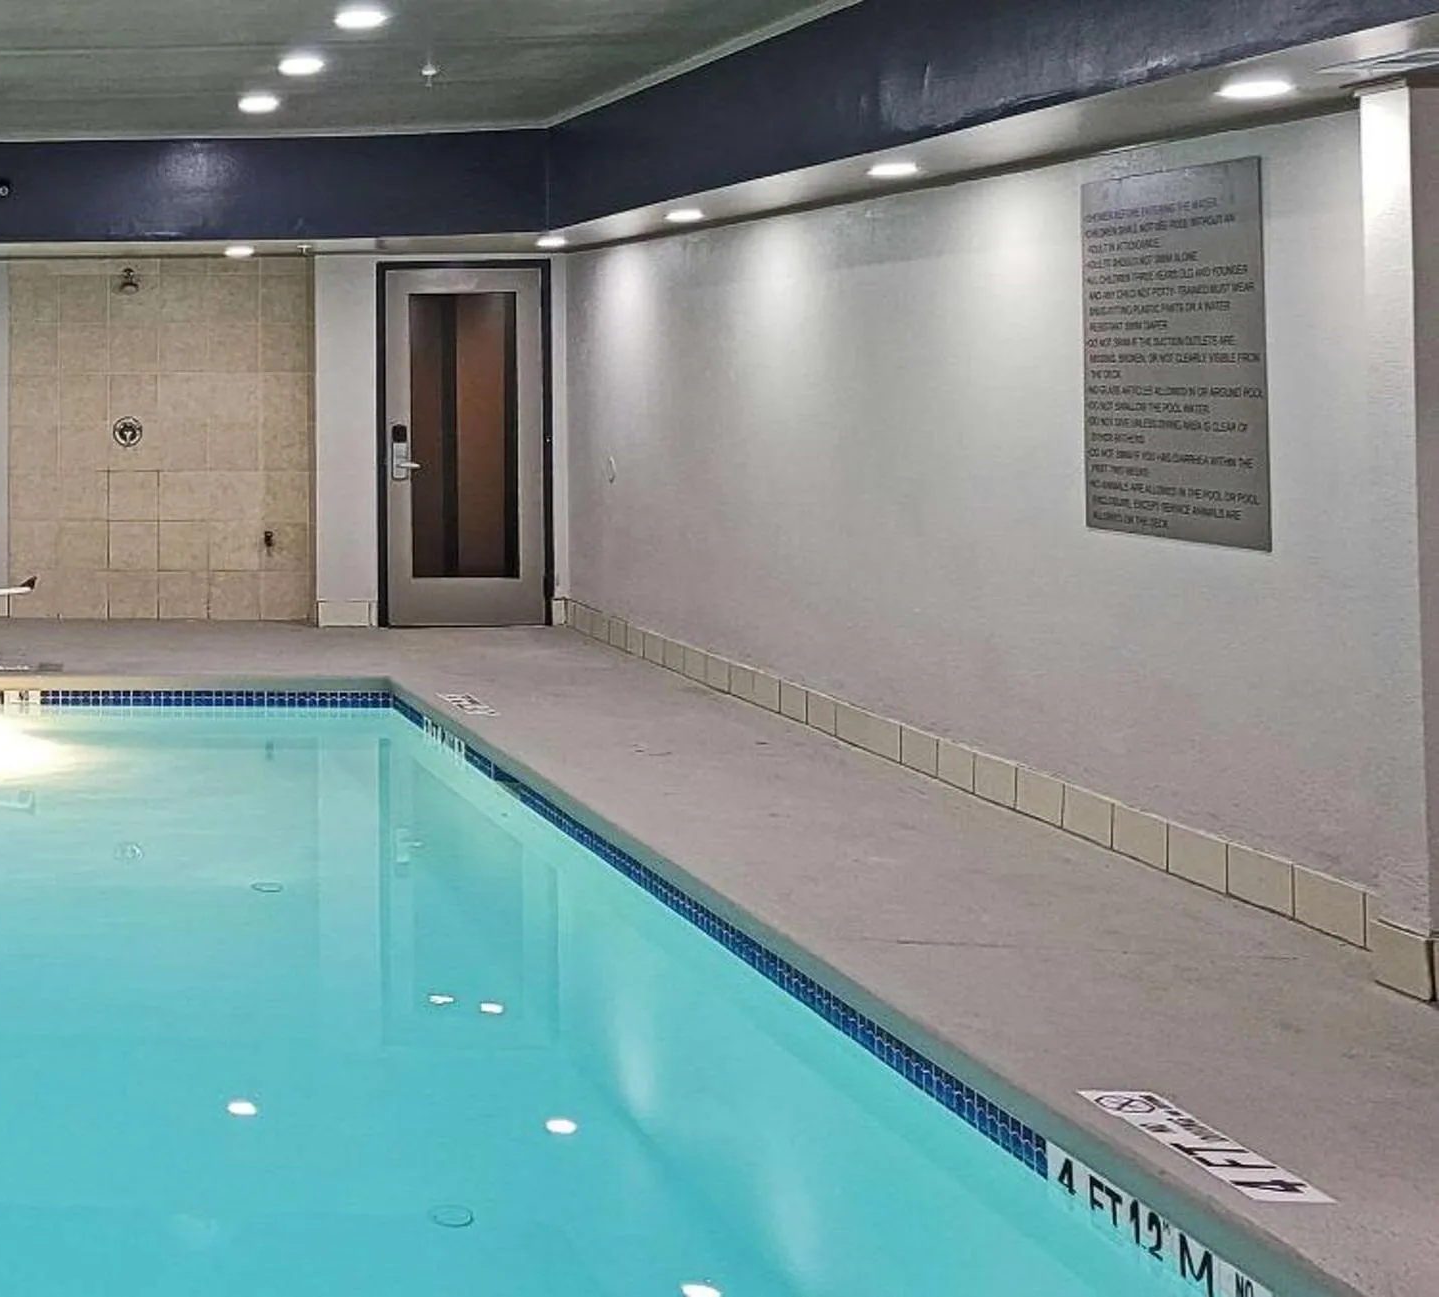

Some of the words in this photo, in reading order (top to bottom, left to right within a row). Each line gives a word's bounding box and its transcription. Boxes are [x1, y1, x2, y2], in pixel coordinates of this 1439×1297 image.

[1169, 1142, 1277, 1169] FT
[1229, 1179, 1308, 1194] 4
[1058, 1158, 1077, 1196] 4
[1089, 1174, 1123, 1229] FT
[1179, 1232, 1214, 1297] M
